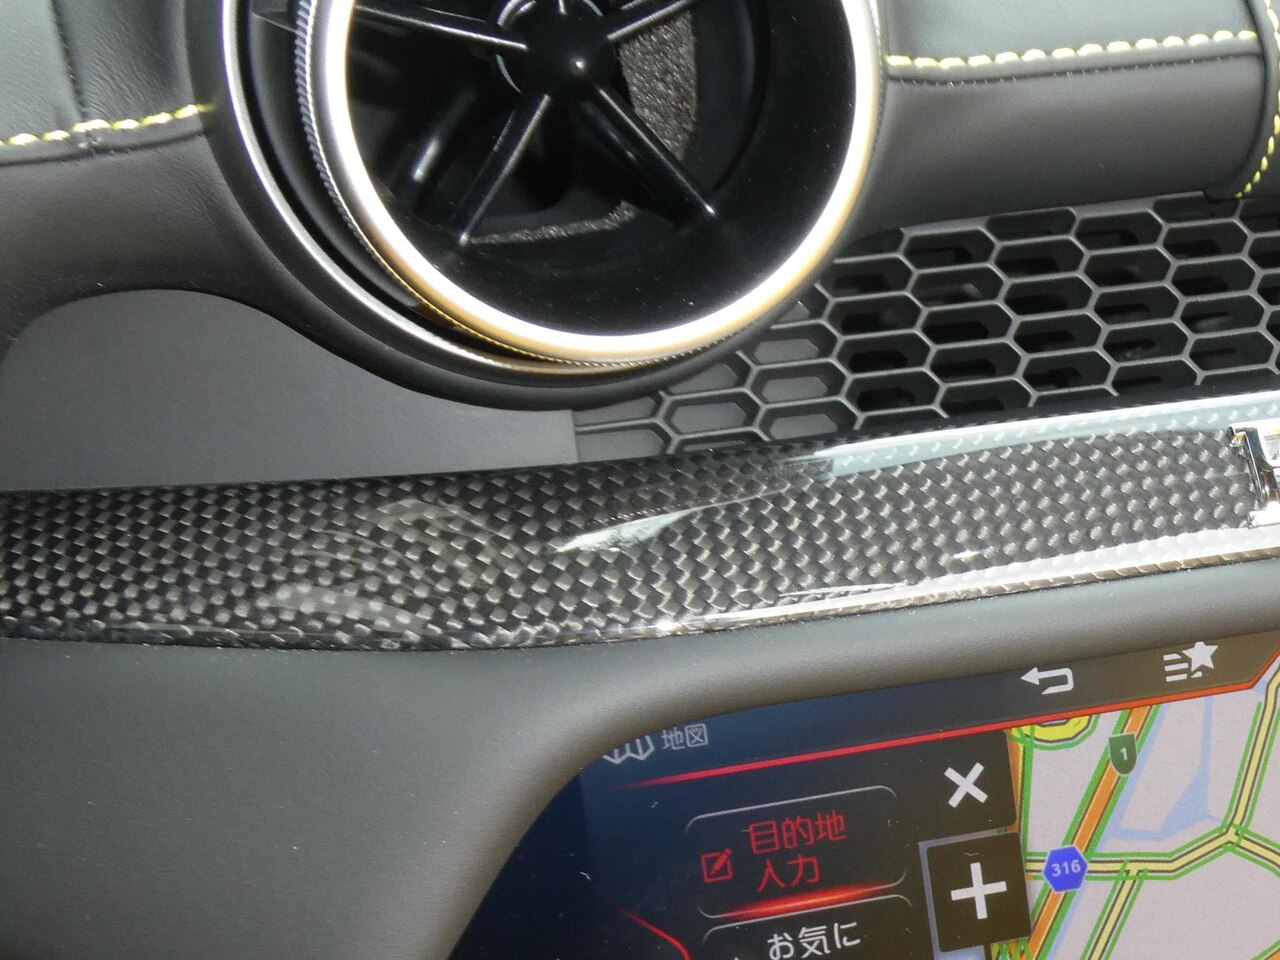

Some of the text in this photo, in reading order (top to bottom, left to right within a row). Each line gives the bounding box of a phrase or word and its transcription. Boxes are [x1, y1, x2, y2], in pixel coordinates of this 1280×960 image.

[660, 723, 708, 751] 地図
[1119, 746, 1129, 763] 1
[749, 810, 847, 852] 目的地
[757, 853, 821, 891] 入力
[1050, 860, 1079, 876] 316
